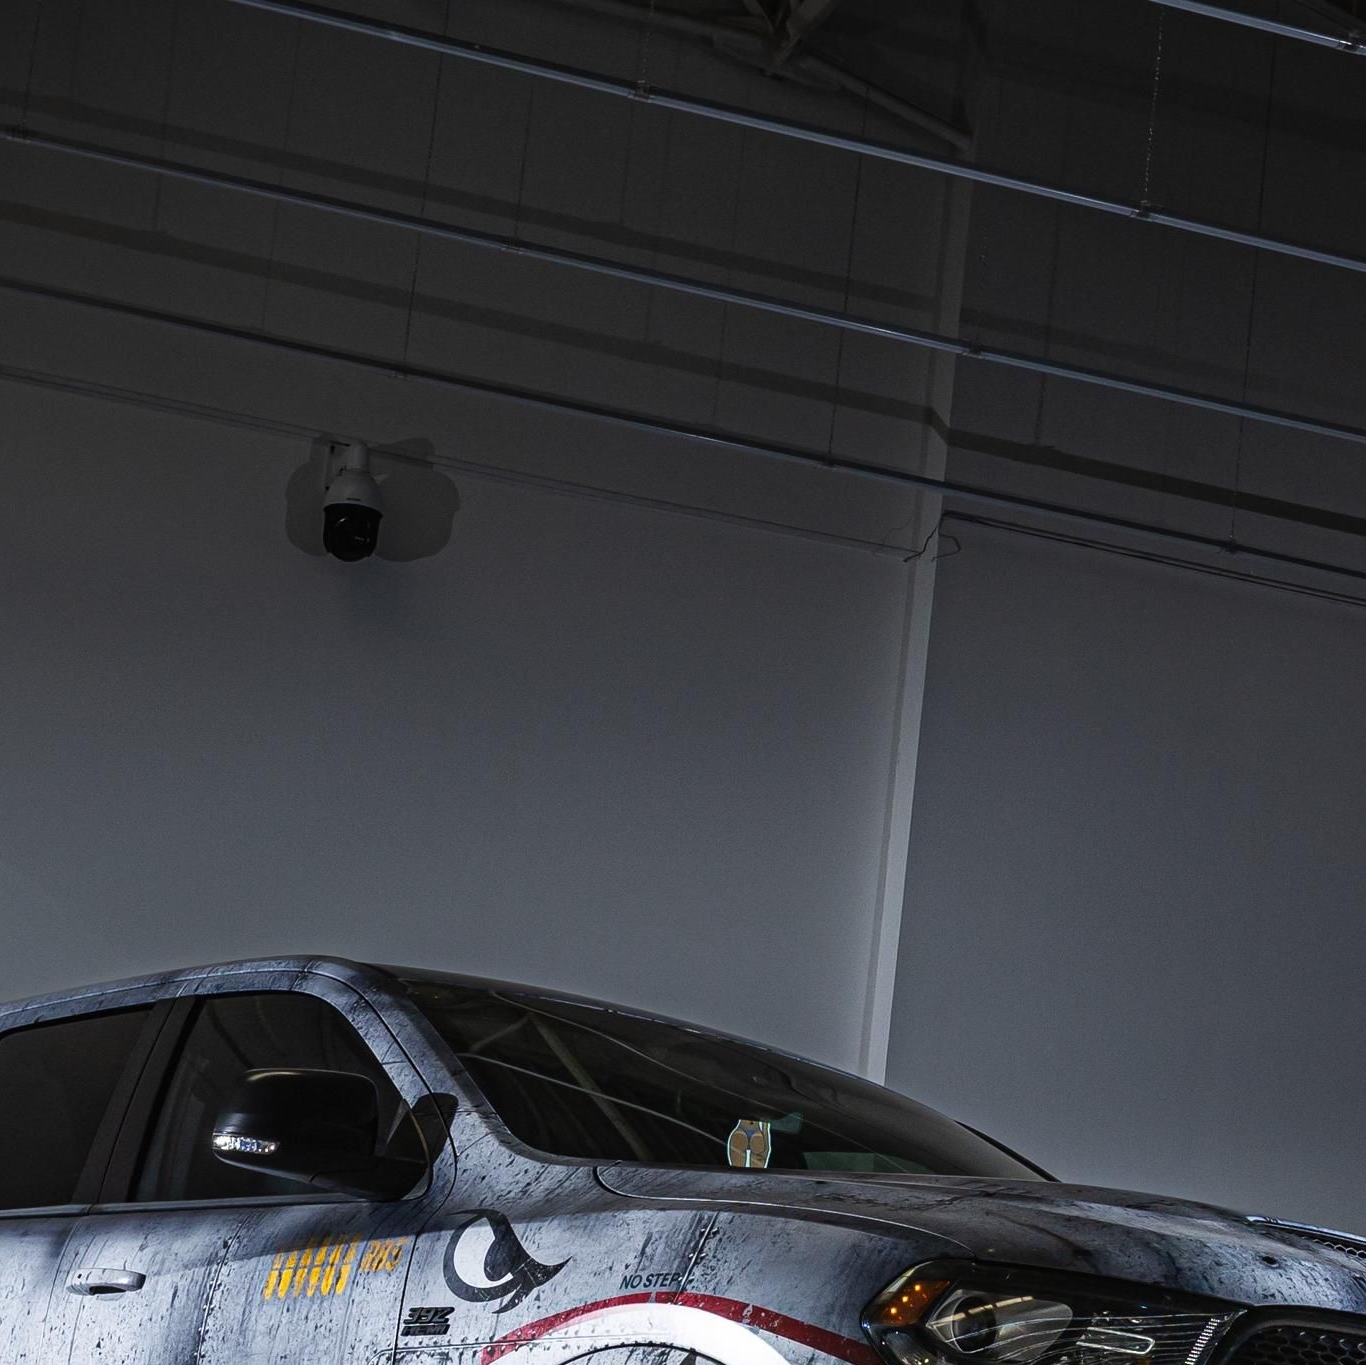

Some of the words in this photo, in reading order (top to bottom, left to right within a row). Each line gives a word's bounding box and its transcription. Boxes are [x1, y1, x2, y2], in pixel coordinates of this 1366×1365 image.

[619, 1273, 643, 1290] NO
[643, 1272, 681, 1289] STEP
[403, 1306, 455, 1325] 392
[400, 1324, 451, 1337] HEMI
